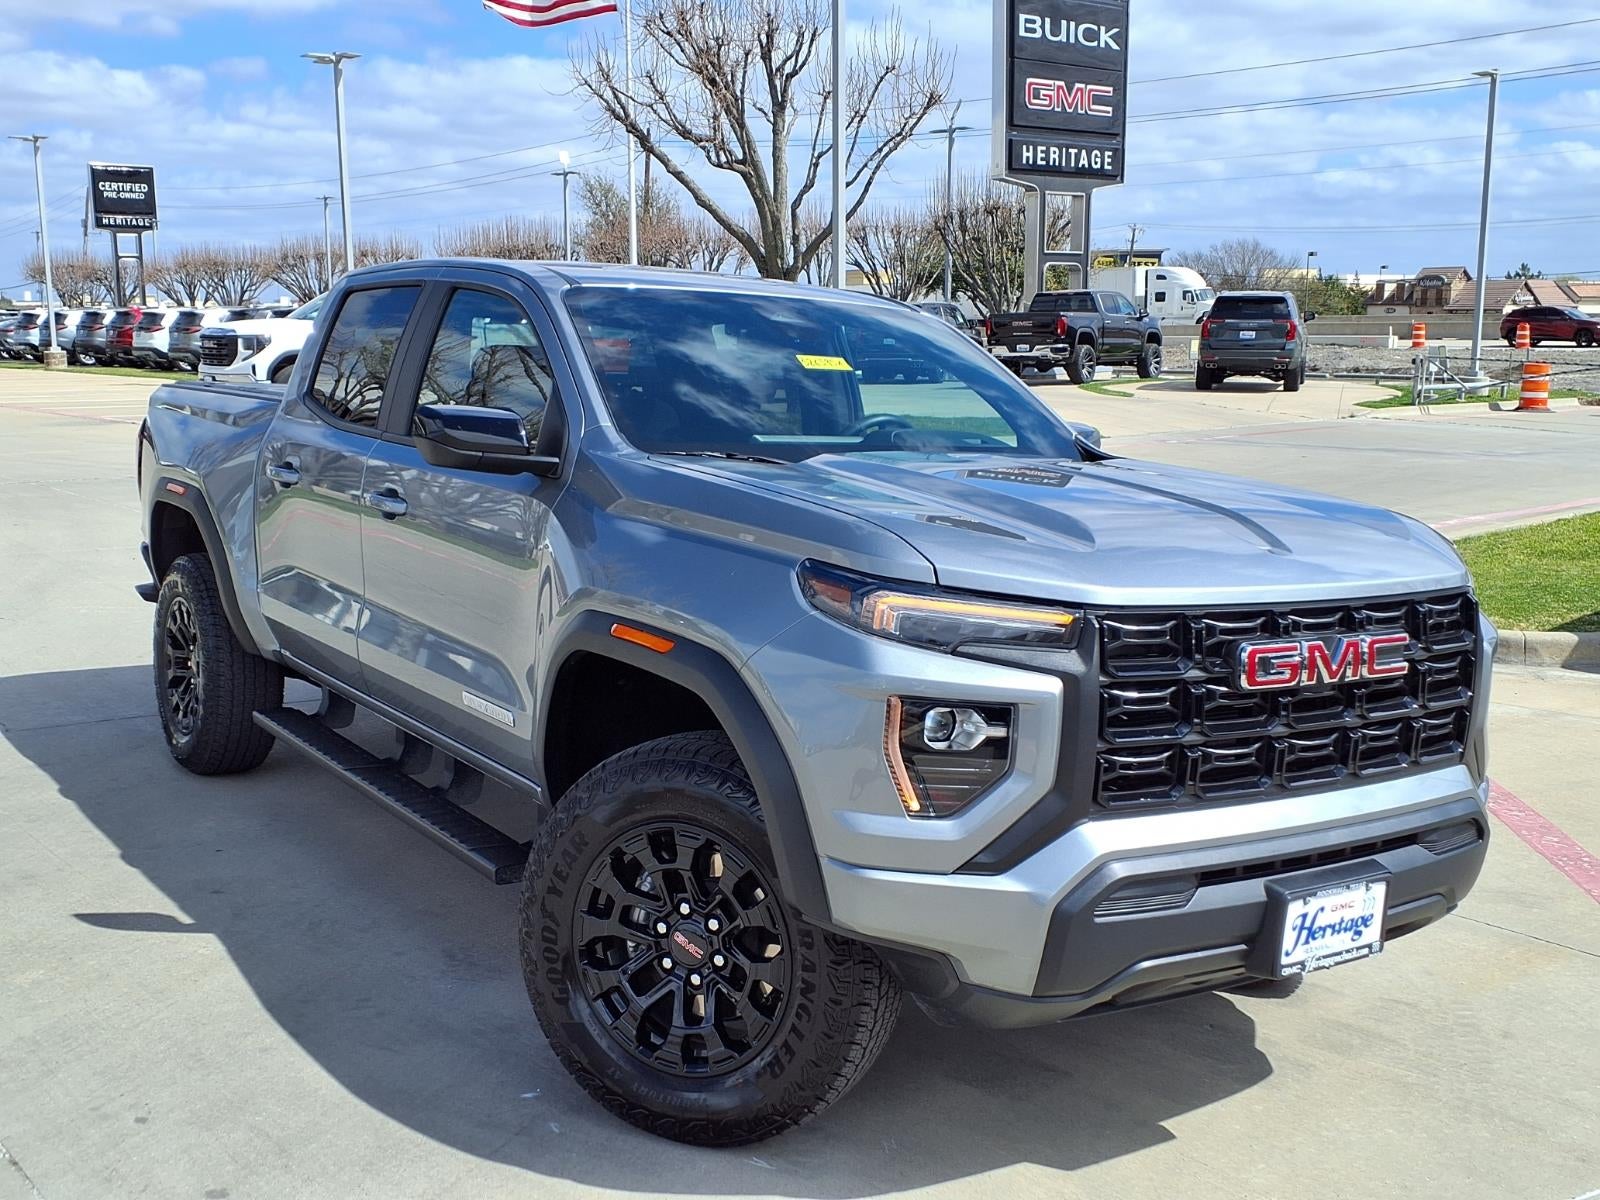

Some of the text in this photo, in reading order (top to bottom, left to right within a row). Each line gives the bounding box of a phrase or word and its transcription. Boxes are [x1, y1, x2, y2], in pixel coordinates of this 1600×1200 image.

[1018, 13, 1120, 50] BUICK
[1025, 77, 1113, 117] GMC
[1022, 144, 1113, 170] HERITAGE
[98, 181, 149, 192] CERTIFIED
[103, 191, 145, 199] PRE-OWNED
[102, 217, 150, 226] HERITAGE
[1240, 632, 1410, 690] GMC
[1330, 900, 1356, 913] GMC
[673, 931, 704, 959] GMC
[1284, 906, 1374, 957] Heritage
[766, 910, 818, 1079] RANGLER
